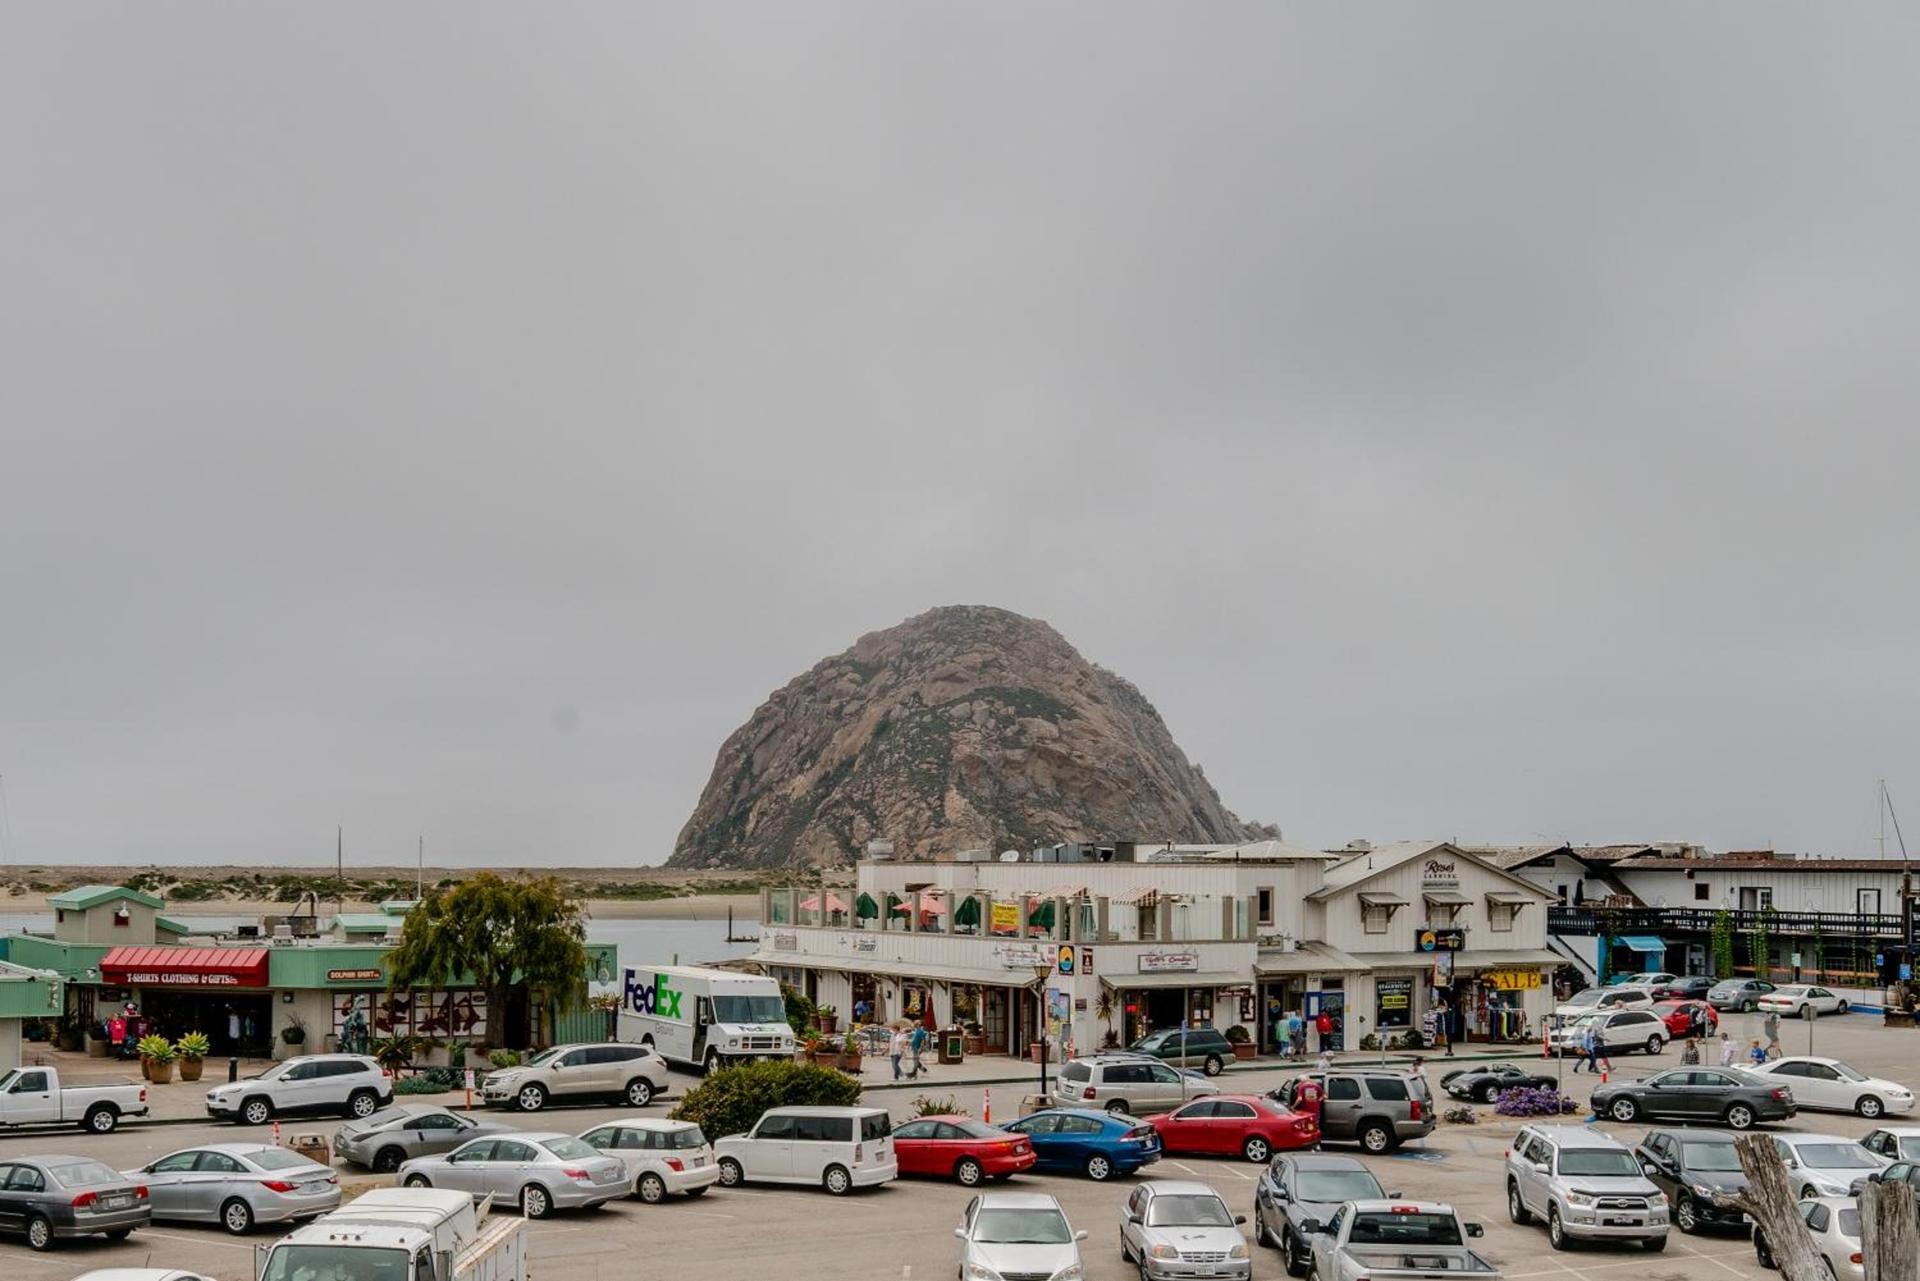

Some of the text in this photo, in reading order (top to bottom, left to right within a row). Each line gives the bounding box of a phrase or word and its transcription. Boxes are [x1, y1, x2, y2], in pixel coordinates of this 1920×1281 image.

[126, 973, 159, 983] T-SHIRTS
[161, 973, 199, 984] CLOTHING
[208, 974, 229, 985] GIFTS
[1487, 971, 1540, 990] SALE
[624, 968, 683, 1020] FedEx
[738, 1025, 777, 1033] FedEx
